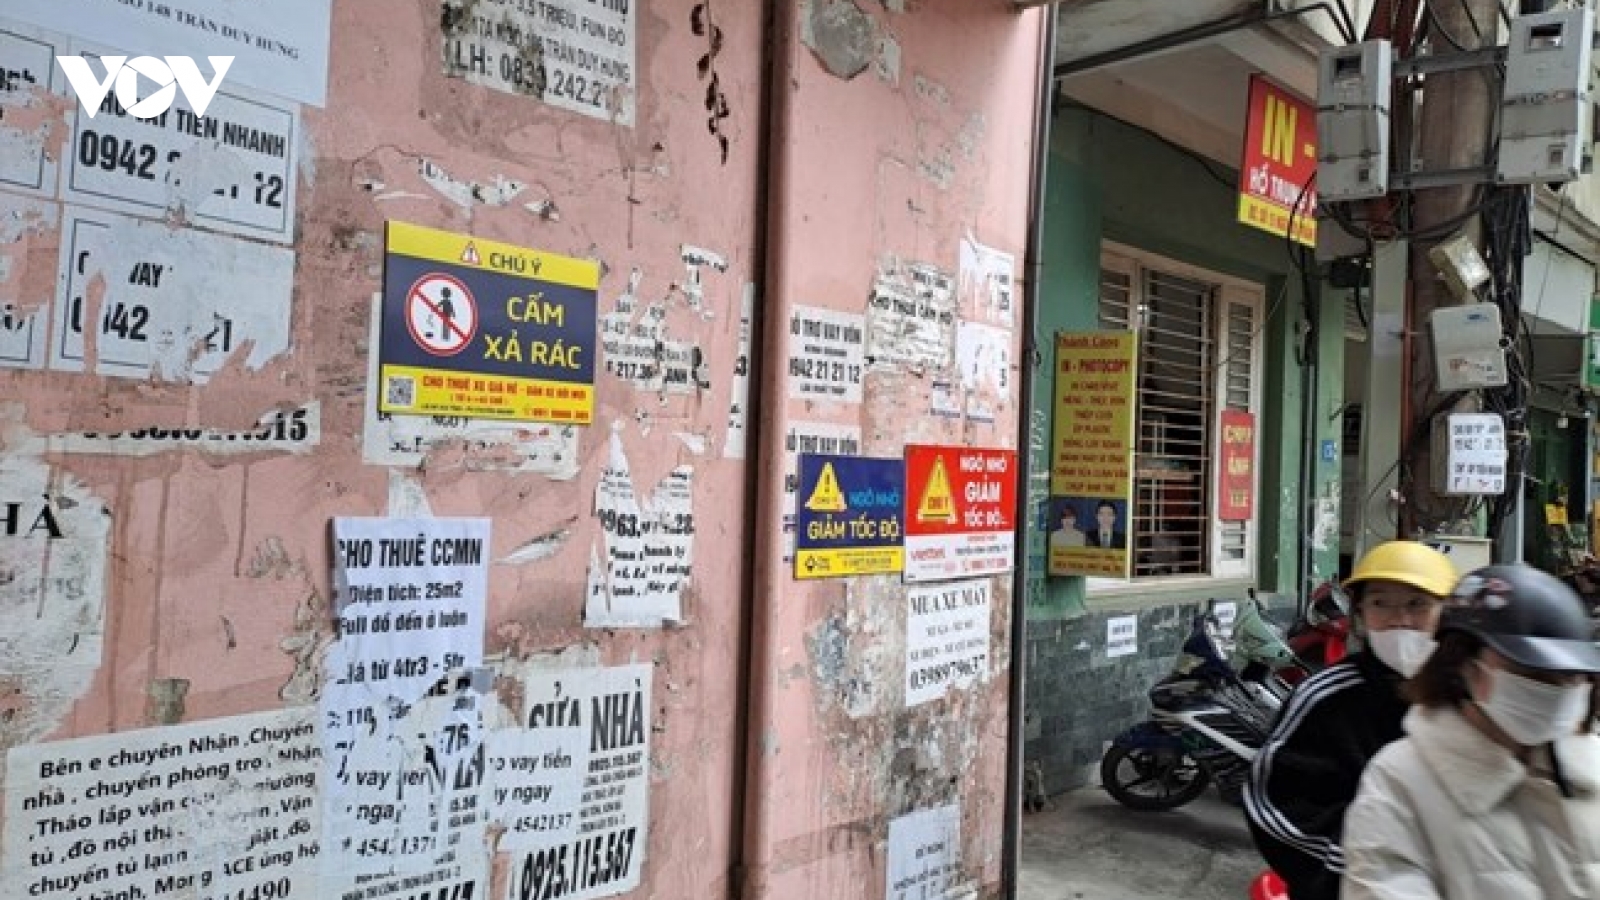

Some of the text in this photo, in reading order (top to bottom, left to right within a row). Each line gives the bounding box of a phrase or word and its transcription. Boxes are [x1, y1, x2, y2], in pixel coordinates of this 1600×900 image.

[222, 120, 286, 159] NHANH
[1262, 93, 1298, 168] IN
[78, 129, 157, 181] 0942
[489, 251, 543, 276] CHÚ Ý
[506, 290, 566, 328] CẤM
[484, 328, 583, 371] XẢ RÁC
[964, 474, 1001, 503] GIẢM
[807, 511, 900, 543] GIẢM TỐC ĐỘ
[378, 532, 427, 569] THUÊ
[430, 538, 484, 567] CCMN
[425, 579, 464, 600] 25m2
[393, 656, 429, 679] 4tr3
[40, 757, 83, 779] Bên
[88, 757, 102, 771] e
[107, 742, 183, 768] chuyên
[188, 732, 240, 755] Nhận
[509, 756, 540, 774] vay
[22, 786, 65, 811] nhà
[85, 769, 161, 800] chuyển
[235, 757, 263, 774] trọ
[356, 770, 391, 791] vay
[511, 784, 553, 805] ngay
[98, 804, 132, 827] lắp
[137, 796, 176, 818] vận
[103, 828, 138, 852] nội
[29, 863, 109, 897] chuyển
